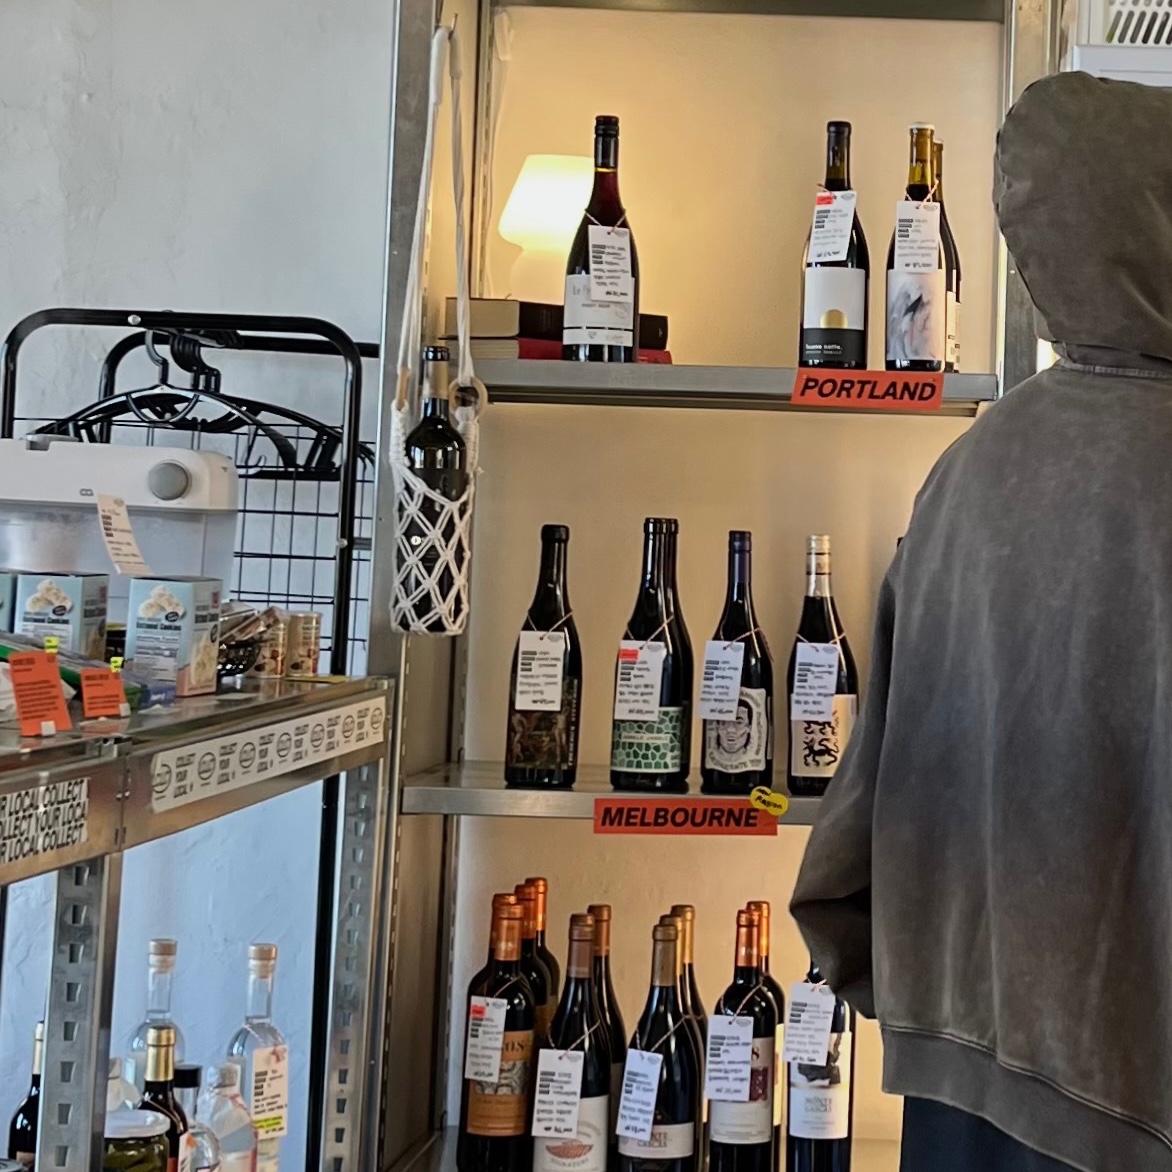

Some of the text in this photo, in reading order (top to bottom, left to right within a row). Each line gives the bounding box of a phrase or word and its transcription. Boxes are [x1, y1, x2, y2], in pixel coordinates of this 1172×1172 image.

[800, 377, 937, 402] PORTLAND
[8, 788, 40, 817] LOCAL
[42, 779, 84, 808] COLLECT
[601, 806, 760, 828] MELBOURNE
[8, 835, 40, 862] LOCAL
[42, 822, 84, 852] COLLECT
